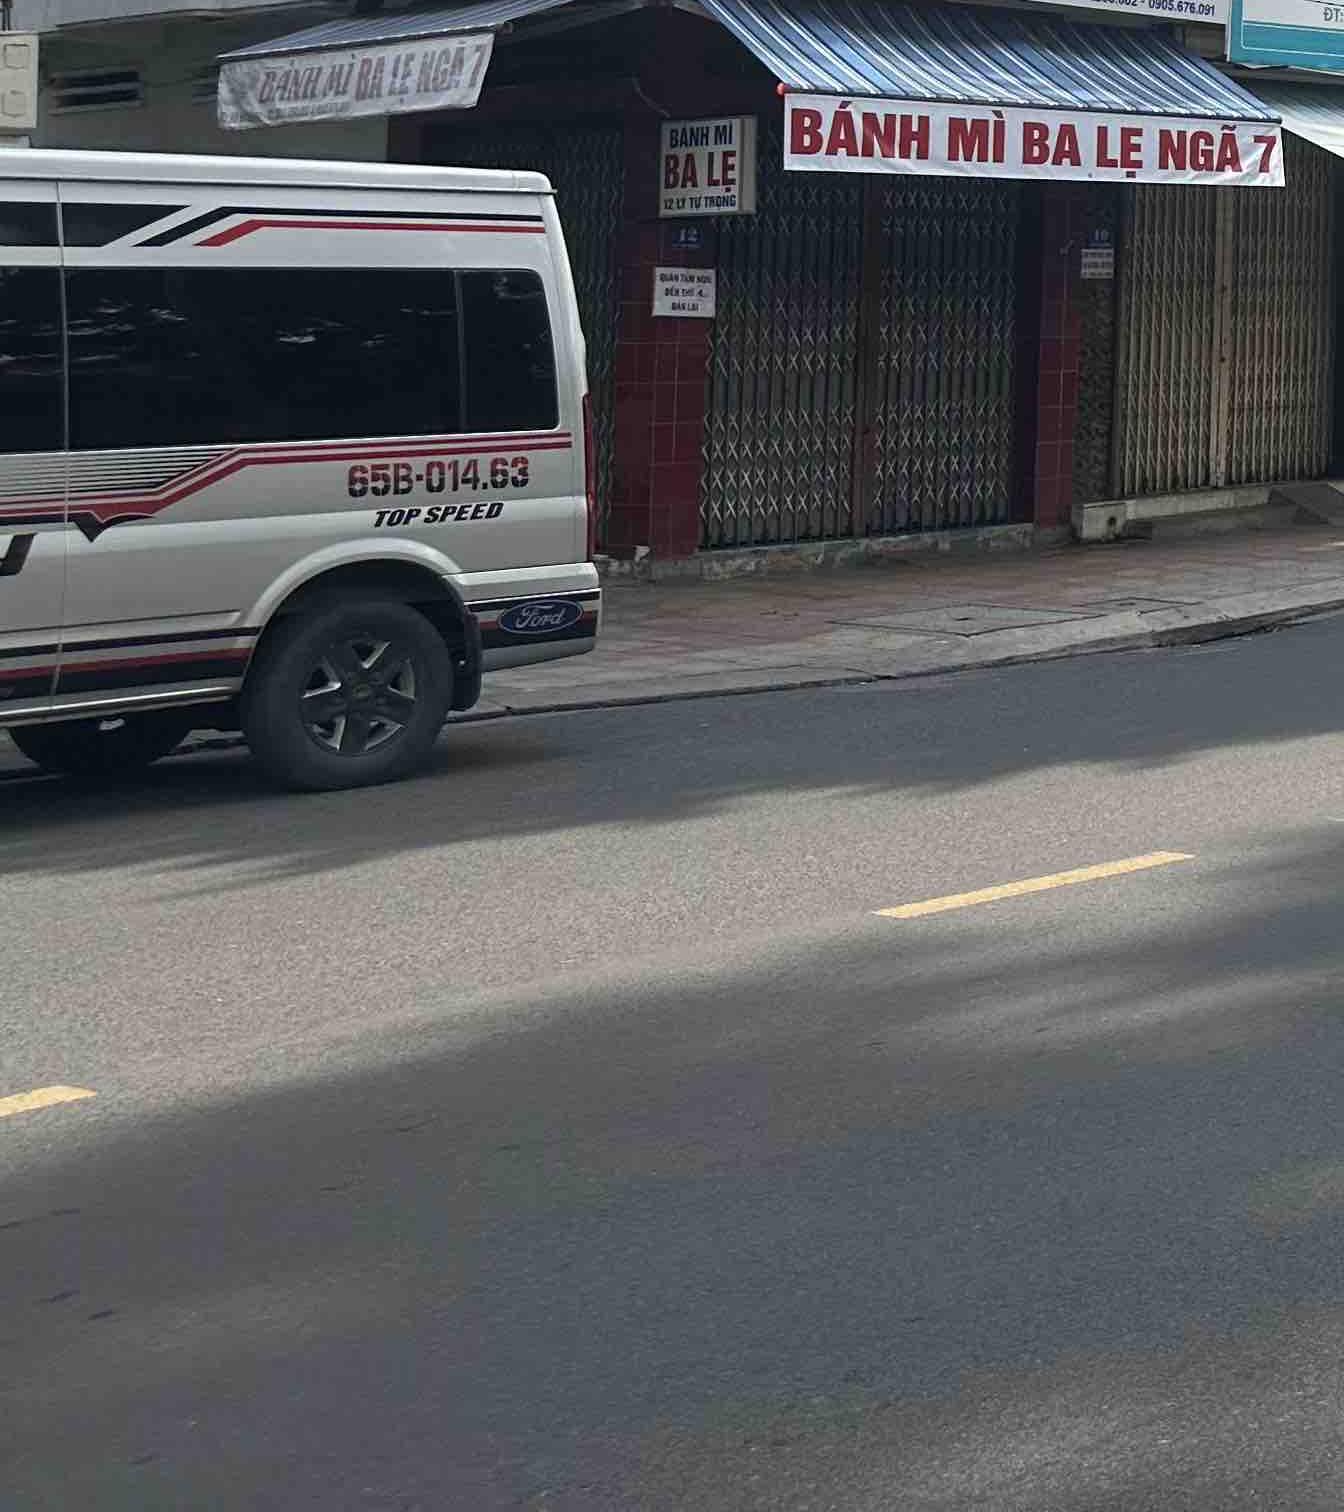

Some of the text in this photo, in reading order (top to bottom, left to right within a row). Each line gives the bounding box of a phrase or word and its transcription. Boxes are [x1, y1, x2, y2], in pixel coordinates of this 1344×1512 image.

[789, 100, 1278, 179] BÁNH MÌ BA LẸ NGÃ 7
[664, 150, 737, 193] BA LẸ
[348, 456, 530, 498] 65B-014.63
[373, 502, 504, 528] TOP SPEED
[514, 604, 567, 630] Ford
